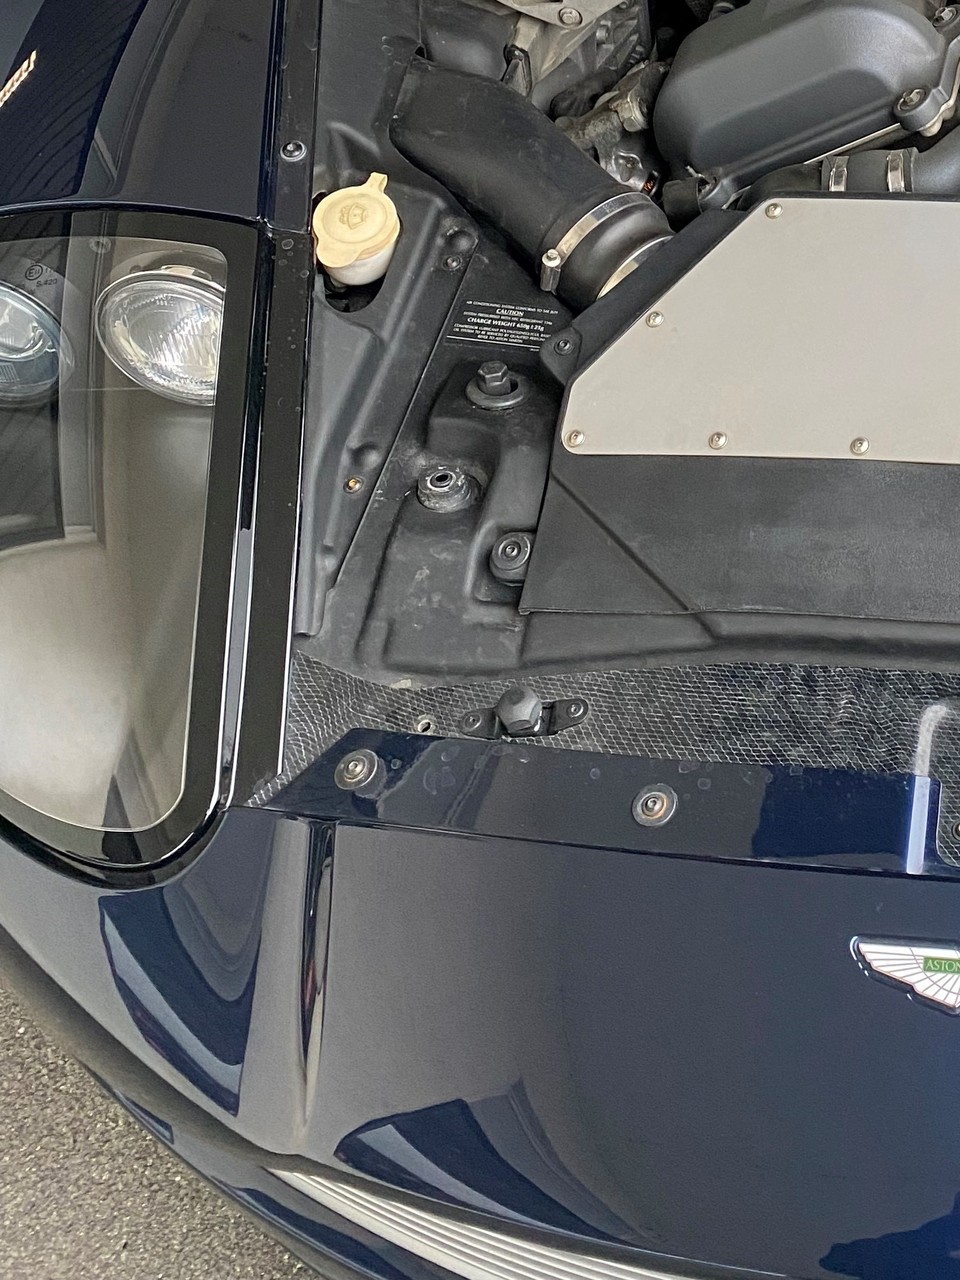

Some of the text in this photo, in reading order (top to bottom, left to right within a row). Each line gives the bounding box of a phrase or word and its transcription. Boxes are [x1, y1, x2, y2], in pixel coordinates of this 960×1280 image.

[496, 308, 525, 317] CAUTION
[467, 317, 492, 325] CHARGE
[492, 320, 516, 328] WEIGHT
